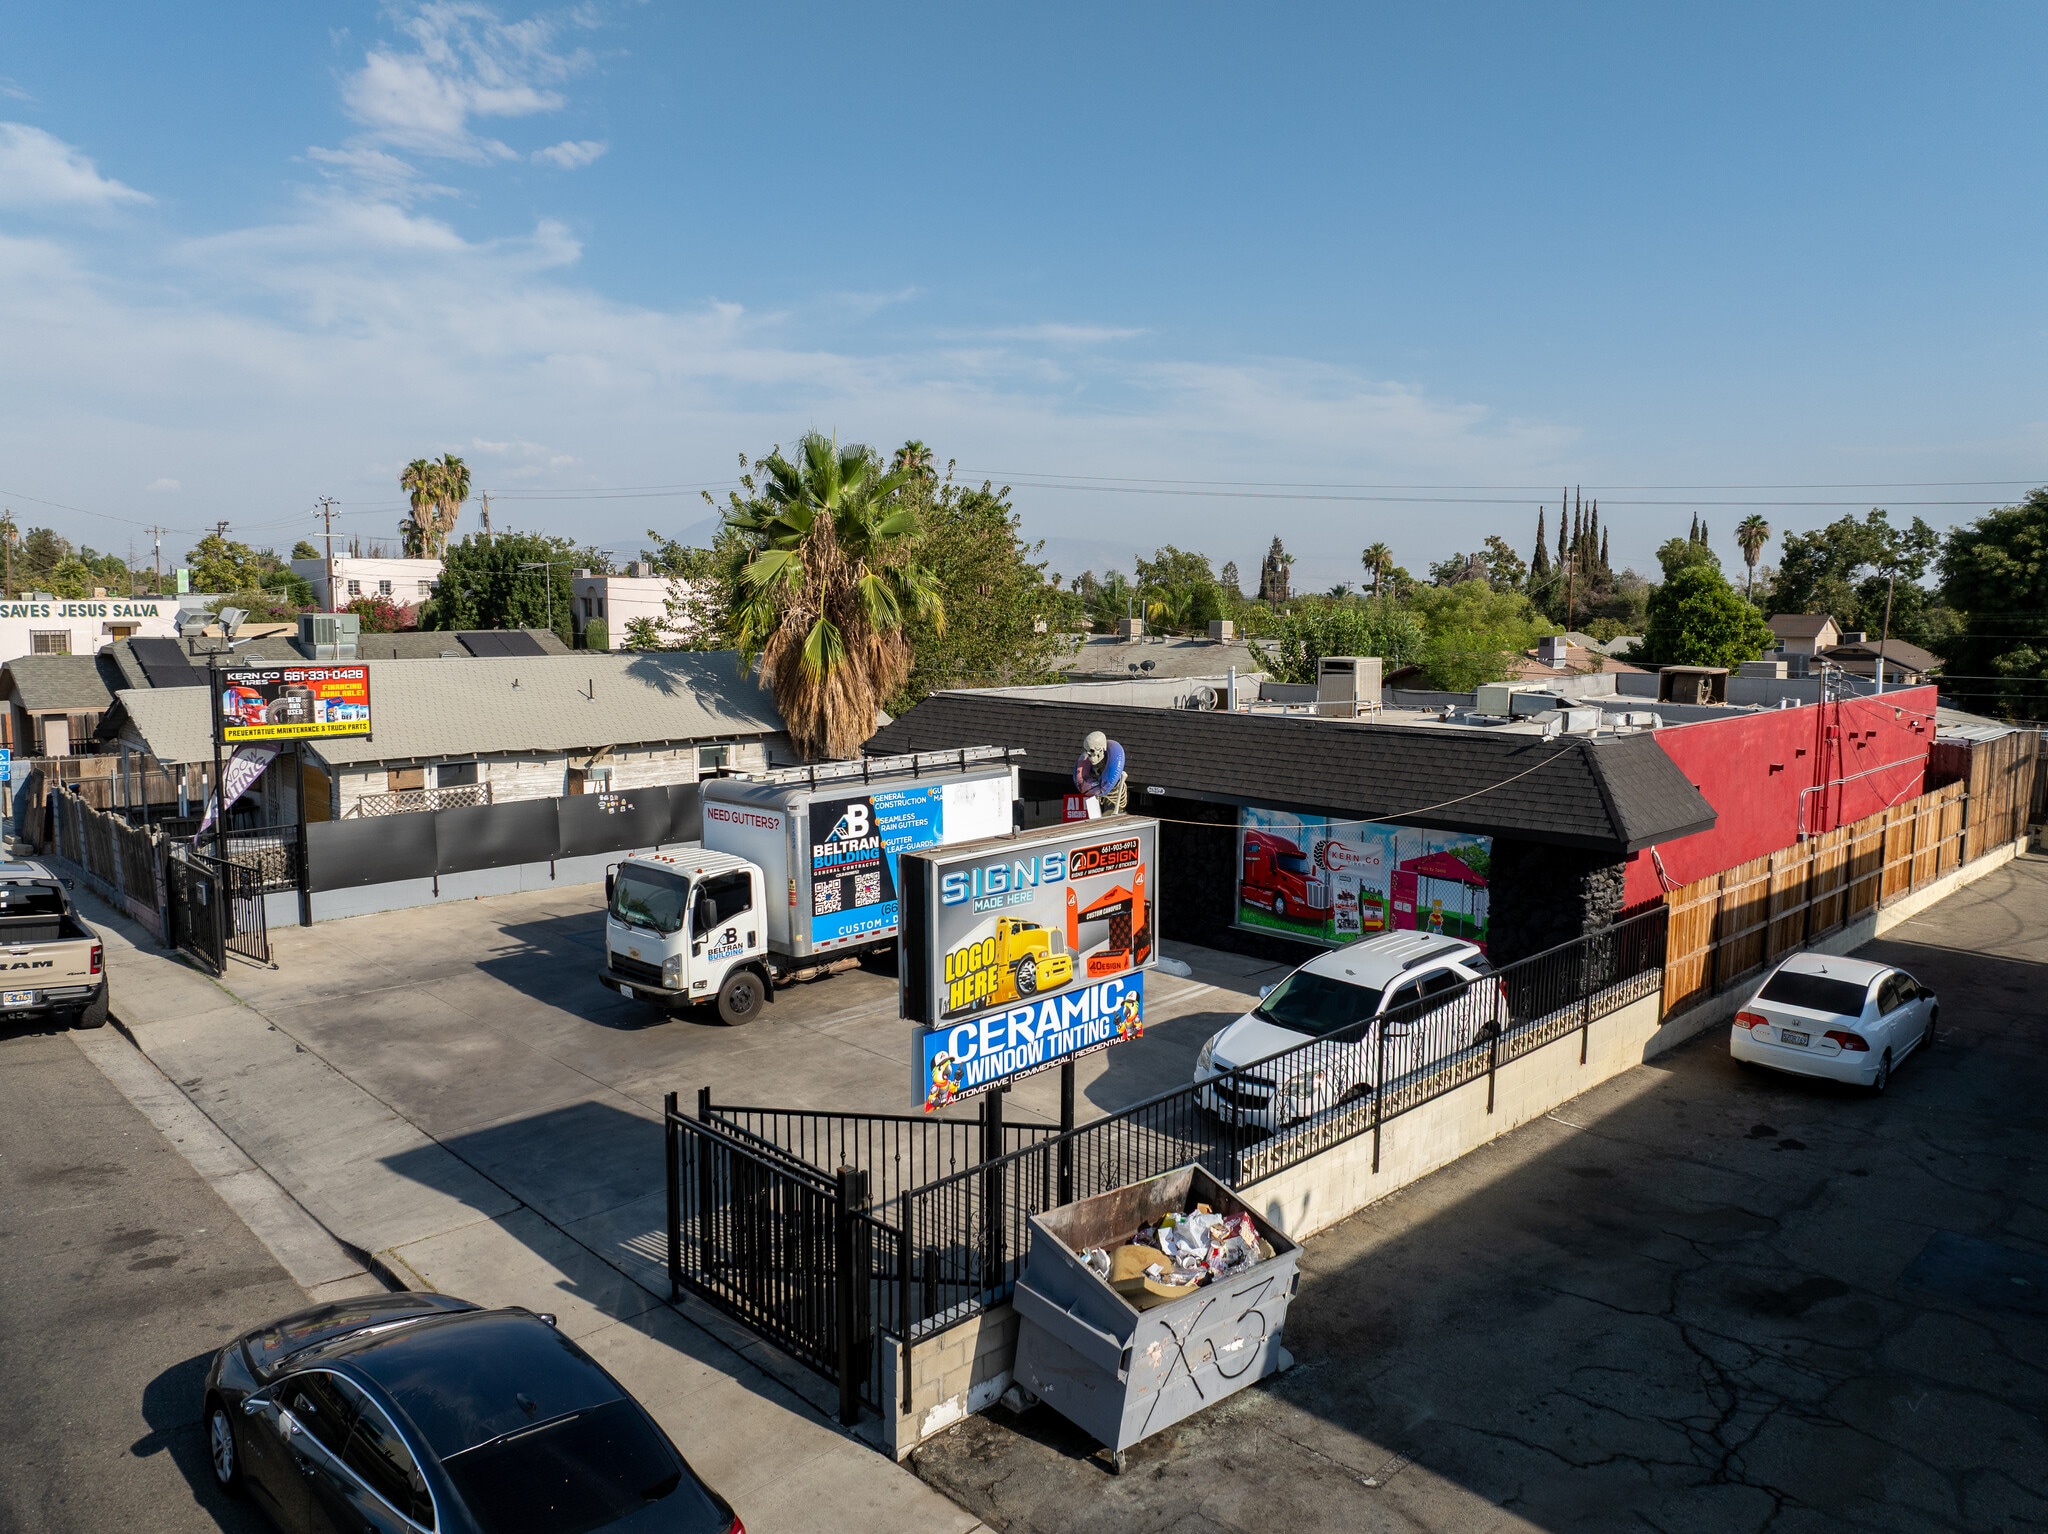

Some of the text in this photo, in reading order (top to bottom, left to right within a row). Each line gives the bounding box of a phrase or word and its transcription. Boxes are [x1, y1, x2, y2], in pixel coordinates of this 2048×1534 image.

[0, 604, 158, 618] SAVES JESUS SALVA
[227, 671, 281, 681] KERN CO
[284, 669, 364, 680] 661-331-0428
[320, 690, 364, 698] AVAILABLE!
[228, 728, 275, 737] PREVENTATIVE
[277, 725, 320, 734] MAINTENANCE
[874, 792, 906, 803] GENERAL
[875, 796, 927, 810] CONSTRUCTION
[707, 807, 780, 830] NEED GUTTERS?
[879, 813, 916, 825] SEAMLESS
[881, 818, 929, 832] RAIN GUTTERS
[813, 836, 880, 858] BELTRAN
[886, 836, 912, 848] GUTTER
[887, 840, 934, 854] LEAF-GUARDS
[1101, 841, 1137, 854] 661-903-6913
[814, 848, 880, 869] BUILDING
[1332, 852, 1380, 865] KERN CO
[814, 868, 841, 876] GENERAL
[842, 861, 880, 872] CONTRACTOR
[941, 851, 1067, 906] SIGNS
[974, 891, 1033, 912] MADE HERE
[1086, 903, 1122, 920] CUSTOM CANOPIES
[838, 919, 881, 935] CUSTOM
[708, 942, 744, 955] BELTRAN
[708, 949, 744, 961] BUILDING
[944, 936, 996, 985] LOGO
[949, 963, 999, 1011] HERE
[948, 978, 1125, 1064] CERAMIC
[966, 1017, 1110, 1086] WINDOW TINTING
[947, 1036, 1125, 1104] AUTOMOTIVE COMMERCIAL RESIDENTIAL
